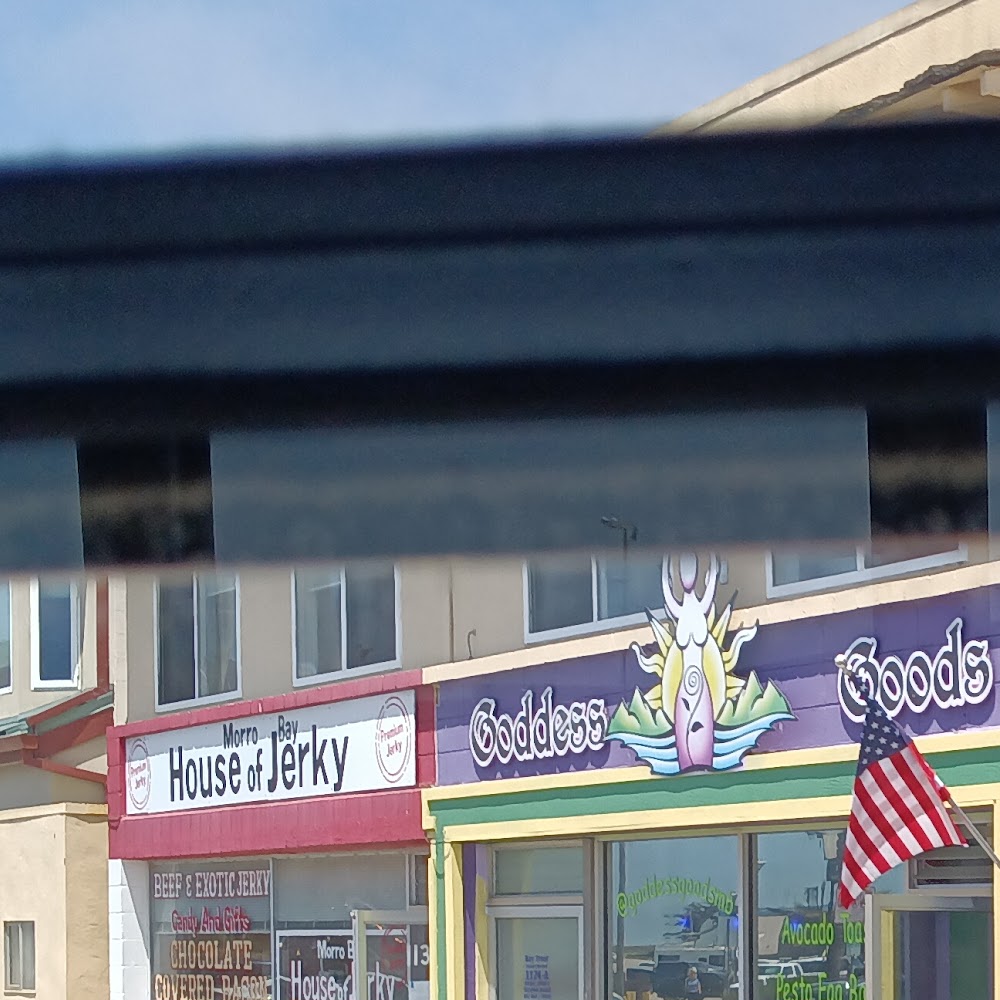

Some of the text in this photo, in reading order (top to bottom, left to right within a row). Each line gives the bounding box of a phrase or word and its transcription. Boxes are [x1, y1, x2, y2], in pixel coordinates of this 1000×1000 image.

[469, 618, 994, 767] Goddess Goods
[223, 715, 299, 750] Morro Bay
[169, 724, 349, 802] House of Jerky
[153, 873, 182, 898] BEEF
[195, 871, 235, 898] EXOTIC
[237, 870, 270, 896] JERKY
[171, 906, 198, 938] Candy
[200, 906, 221, 933] And
[781, 912, 867, 945] Avocado Toa
[170, 939, 253, 971] CHOCOLATE
[317, 939, 345, 959] Morro
